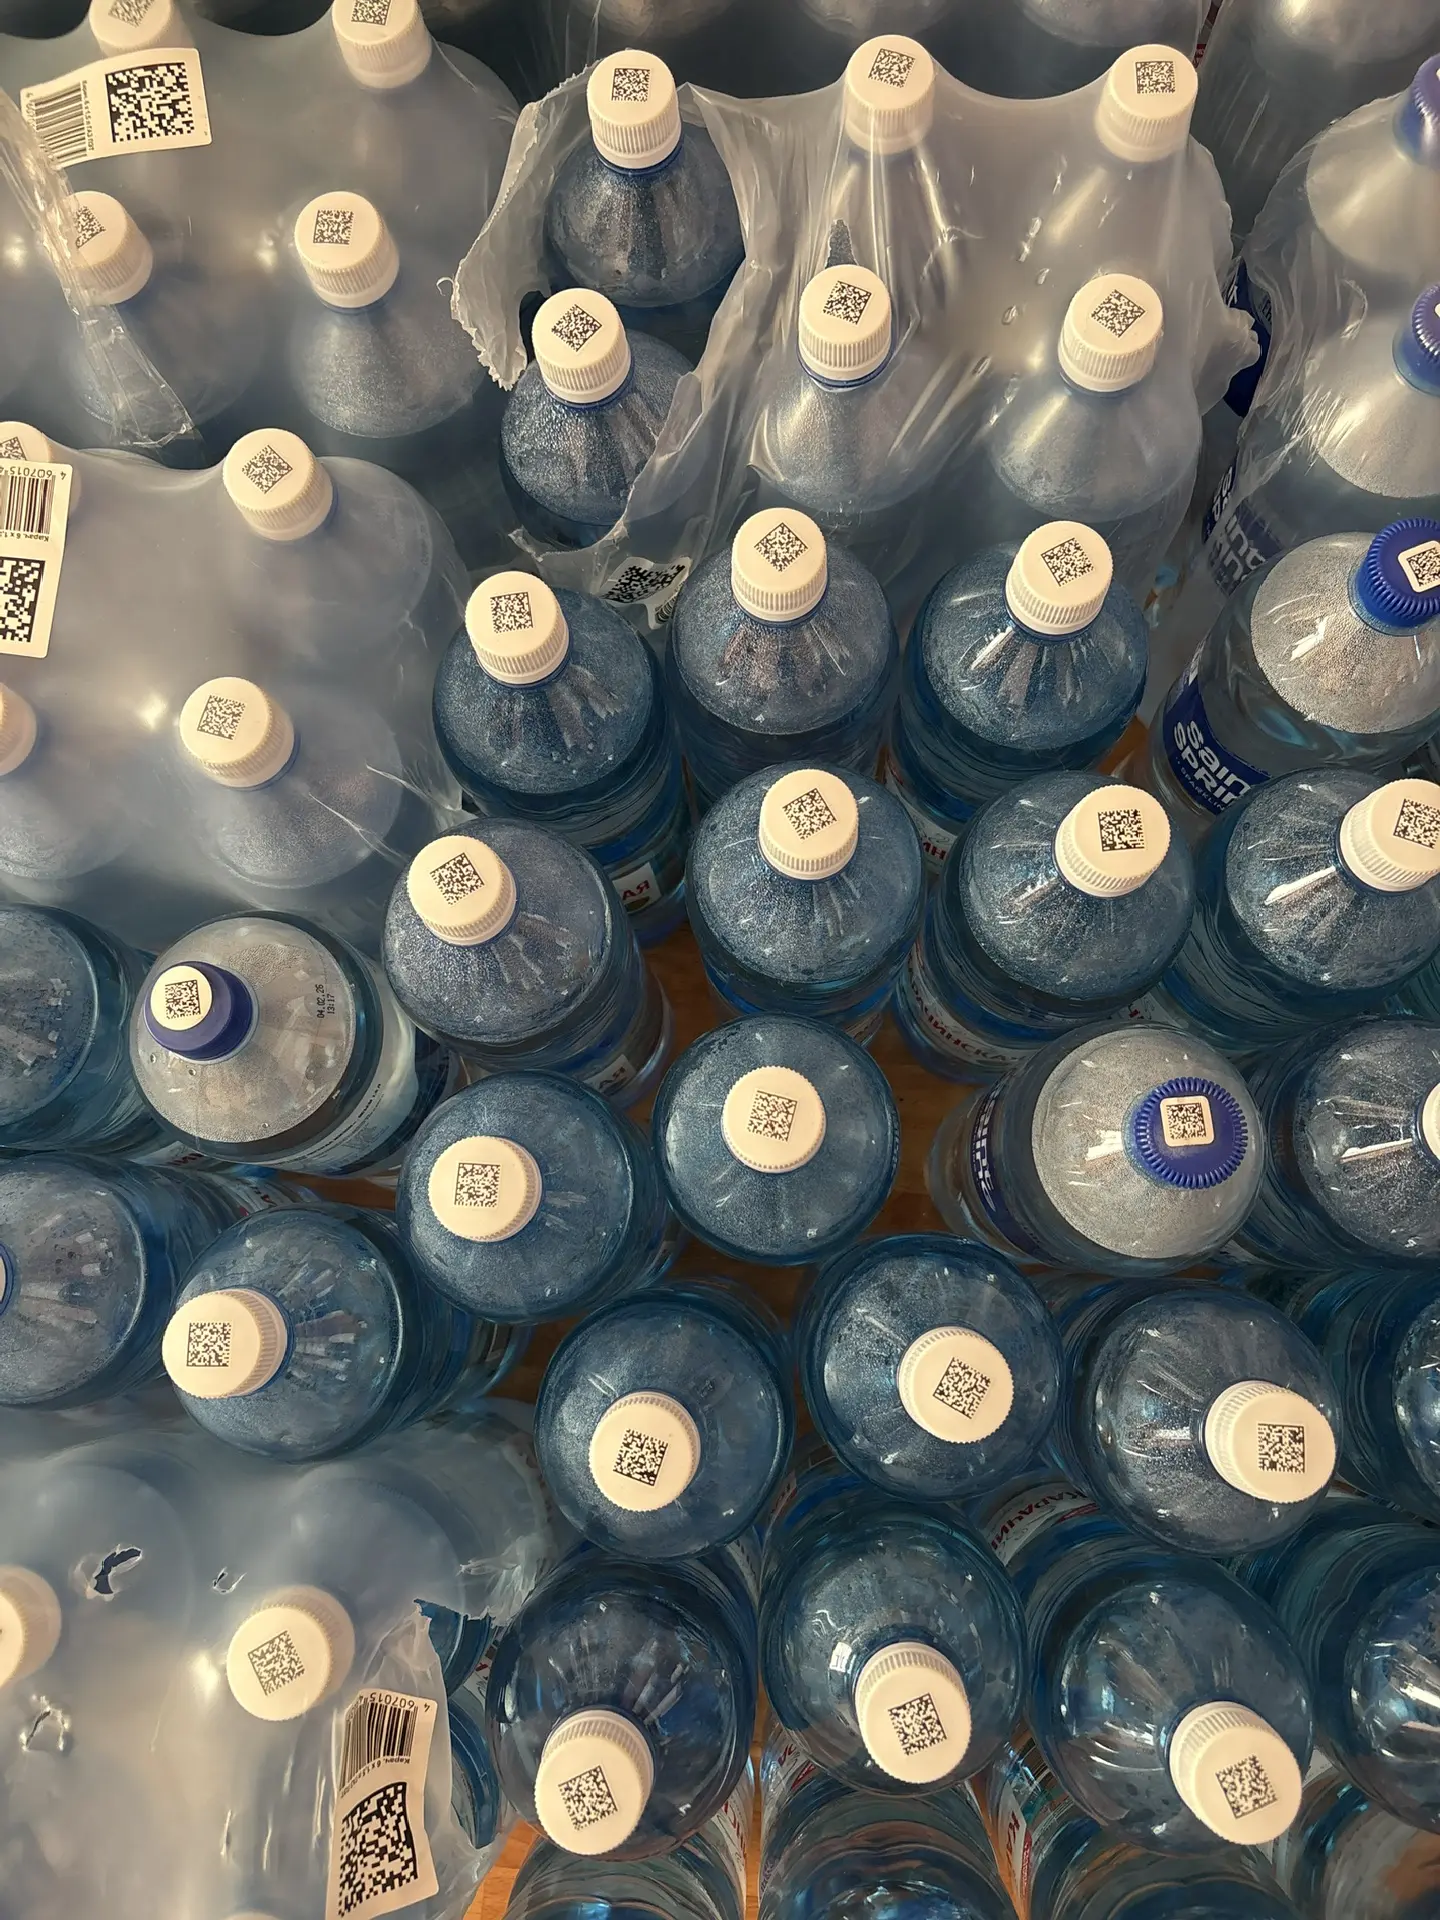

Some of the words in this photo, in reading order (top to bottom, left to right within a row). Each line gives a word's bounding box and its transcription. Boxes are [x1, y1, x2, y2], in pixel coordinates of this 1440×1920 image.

[9, 466, 53, 478] 607015
[315, 984, 326, 1019] 04.02.26
[326, 993, 336, 1014] 13:17
[369, 1692, 416, 1709] 607015
[423, 1702, 430, 1712] 4
